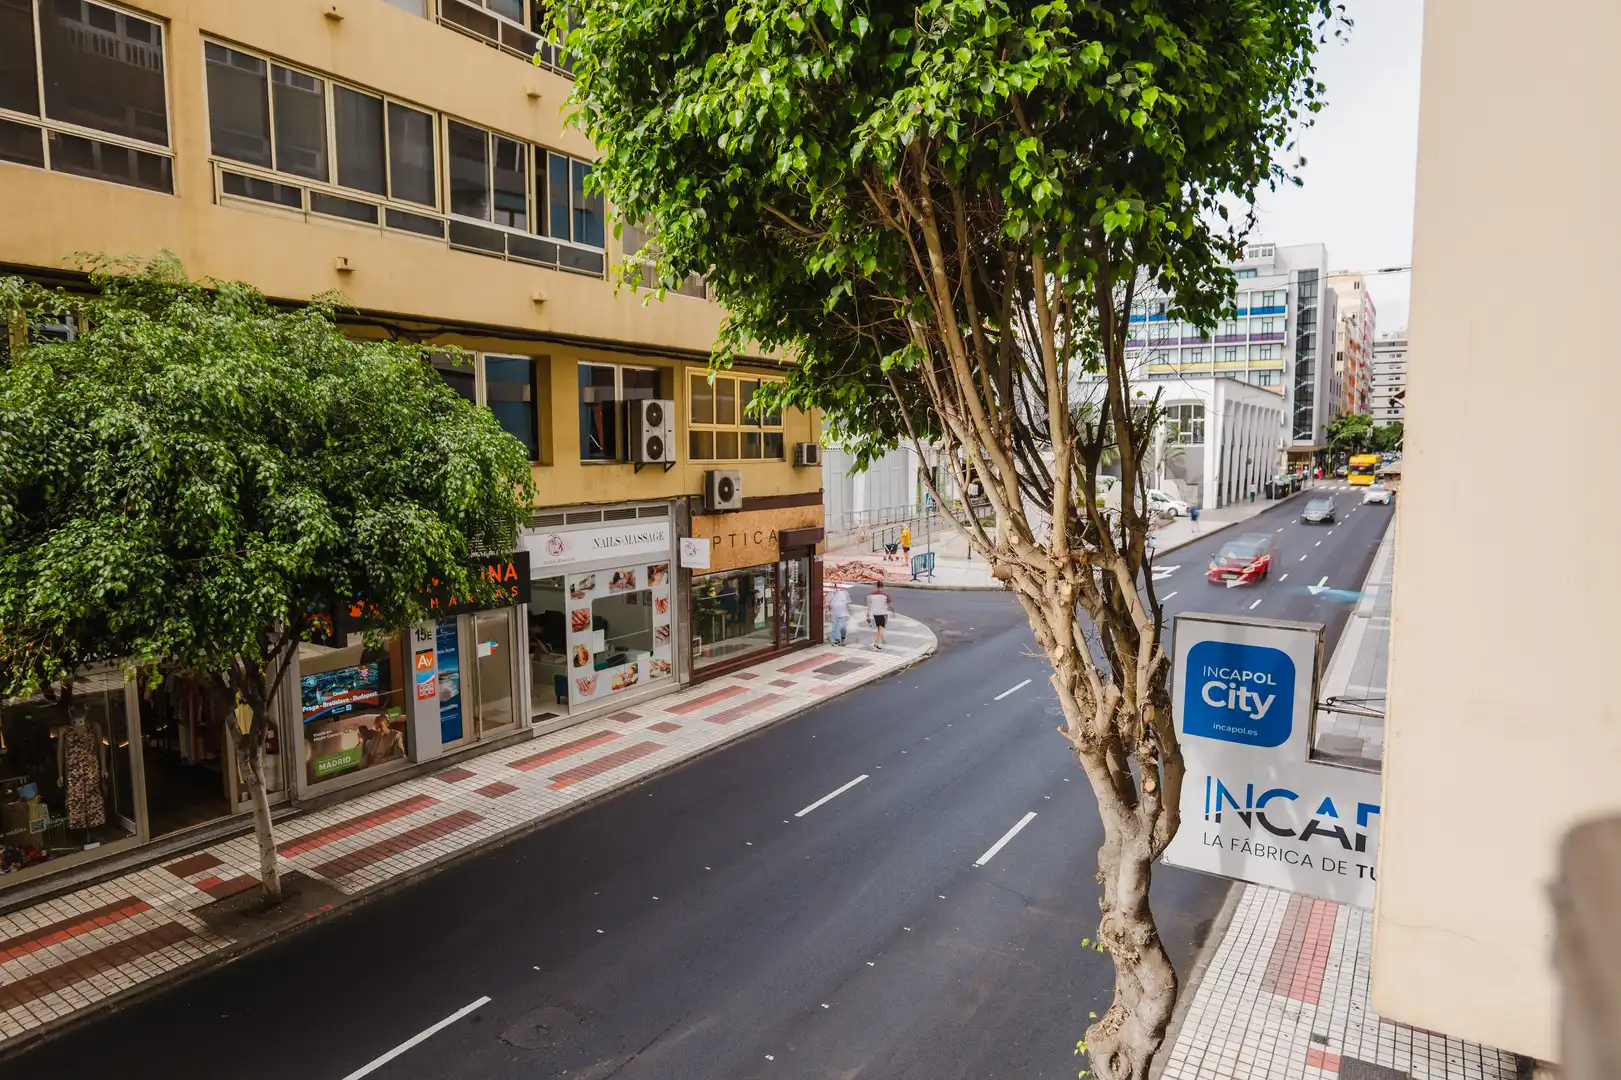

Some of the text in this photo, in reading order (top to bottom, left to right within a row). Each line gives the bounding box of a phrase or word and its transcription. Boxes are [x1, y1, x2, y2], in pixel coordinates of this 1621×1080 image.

[712, 529, 779, 551] PTICA
[415, 628, 433, 642] 15E
[1202, 665, 1277, 686] INCAPOL
[322, 698, 350, 708] Bratislava
[352, 691, 378, 701] Budapest
[1201, 681, 1277, 721] City
[1212, 721, 1258, 737] incapol.es
[318, 756, 352, 771] MADRID
[1203, 832, 1224, 849] LA
[1230, 837, 1314, 869] FÁBRICA
[1321, 857, 1348, 876] DE
